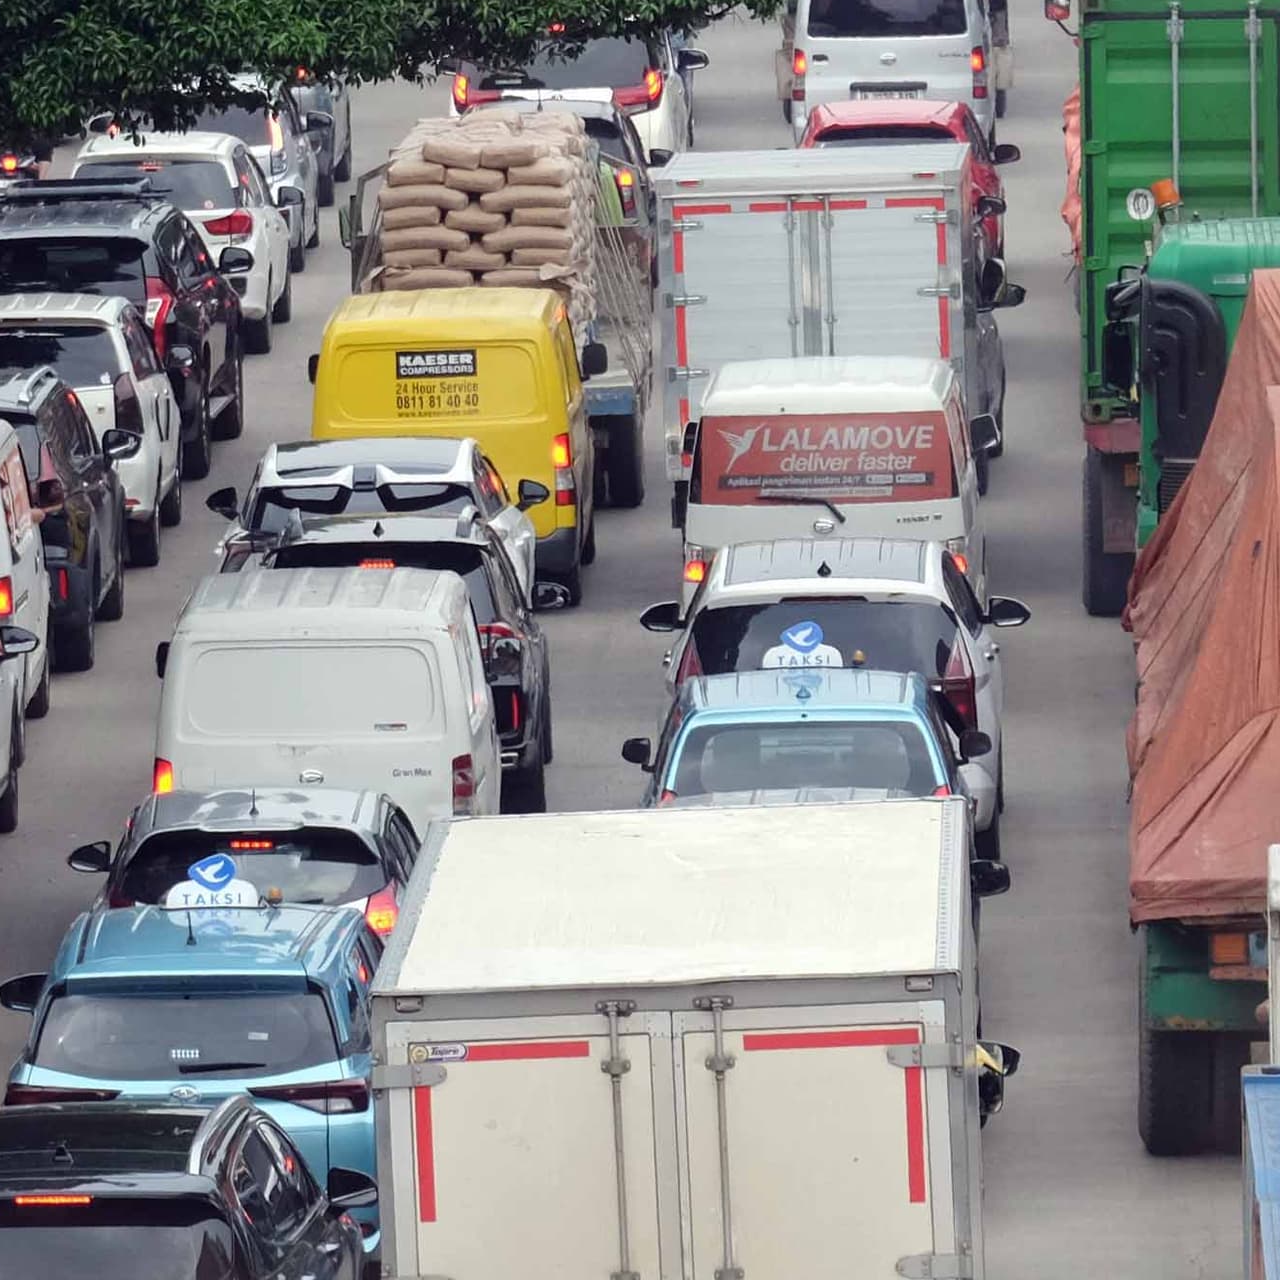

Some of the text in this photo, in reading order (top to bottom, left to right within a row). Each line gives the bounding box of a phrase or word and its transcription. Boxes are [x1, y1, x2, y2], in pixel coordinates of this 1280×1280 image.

[399, 353, 474, 367] KAESER
[400, 364, 474, 375] COMPRESSORS
[396, 380, 479, 395] 24 Hour Service
[396, 393, 479, 410] 0811 81 40 40
[761, 425, 935, 452] LALAMOVE
[780, 450, 917, 472] deliver faster
[777, 655, 831, 666] TAKSI
[182, 893, 242, 906] TAKSI
